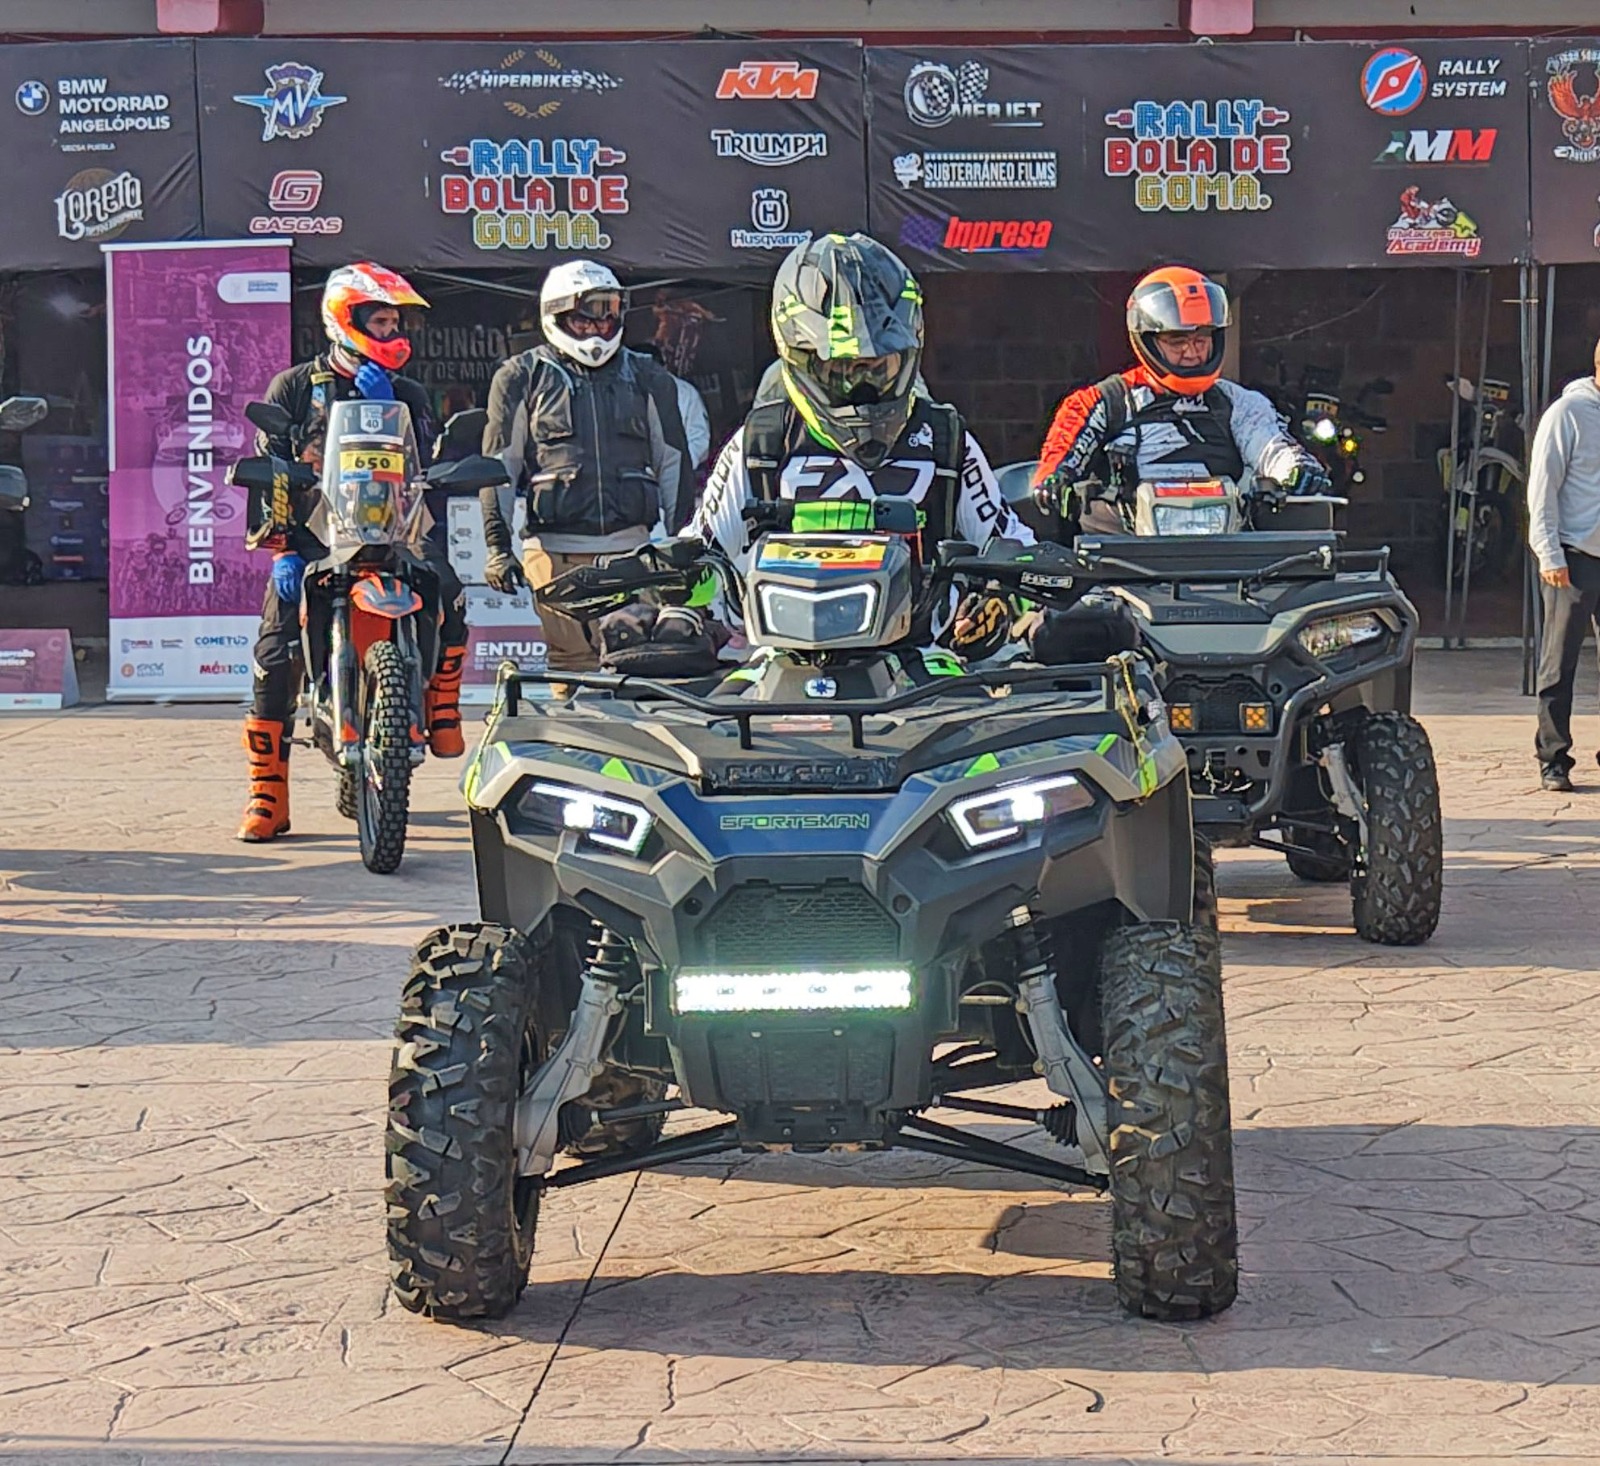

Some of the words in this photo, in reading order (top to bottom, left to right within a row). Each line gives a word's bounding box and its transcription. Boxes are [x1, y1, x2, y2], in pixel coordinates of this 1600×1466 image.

[1438, 59, 1501, 76] RALLY
[58, 78, 107, 95] BMW
[480, 73, 583, 88] HIPERBIKES
[715, 61, 819, 99] KTM
[1431, 81, 1507, 98] SYSTEM
[59, 95, 169, 114] MOTORRAD
[60, 114, 170, 133] ANGELÓPOLIS
[1134, 99, 1263, 139] RALLY
[711, 129, 828, 161] TRIUMPH
[470, 138, 600, 176] RALLY
[1105, 138, 1216, 176] BOLA
[1231, 135, 1291, 174] DE
[924, 159, 1015, 181] SUBTERRÁNEO
[1018, 161, 1056, 181] FILMS
[441, 175, 555, 213] BOLA
[569, 175, 629, 214] DE
[249, 216, 343, 234] GASGAS
[732, 230, 813, 249] Husqvarna
[1386, 237, 1481, 257] Academy
[187, 335, 214, 585] BIENVENIDOS
[355, 457, 390, 470] 650
[474, 641, 548, 657] ENTUD
[720, 812, 870, 830] SPORTSMAN
